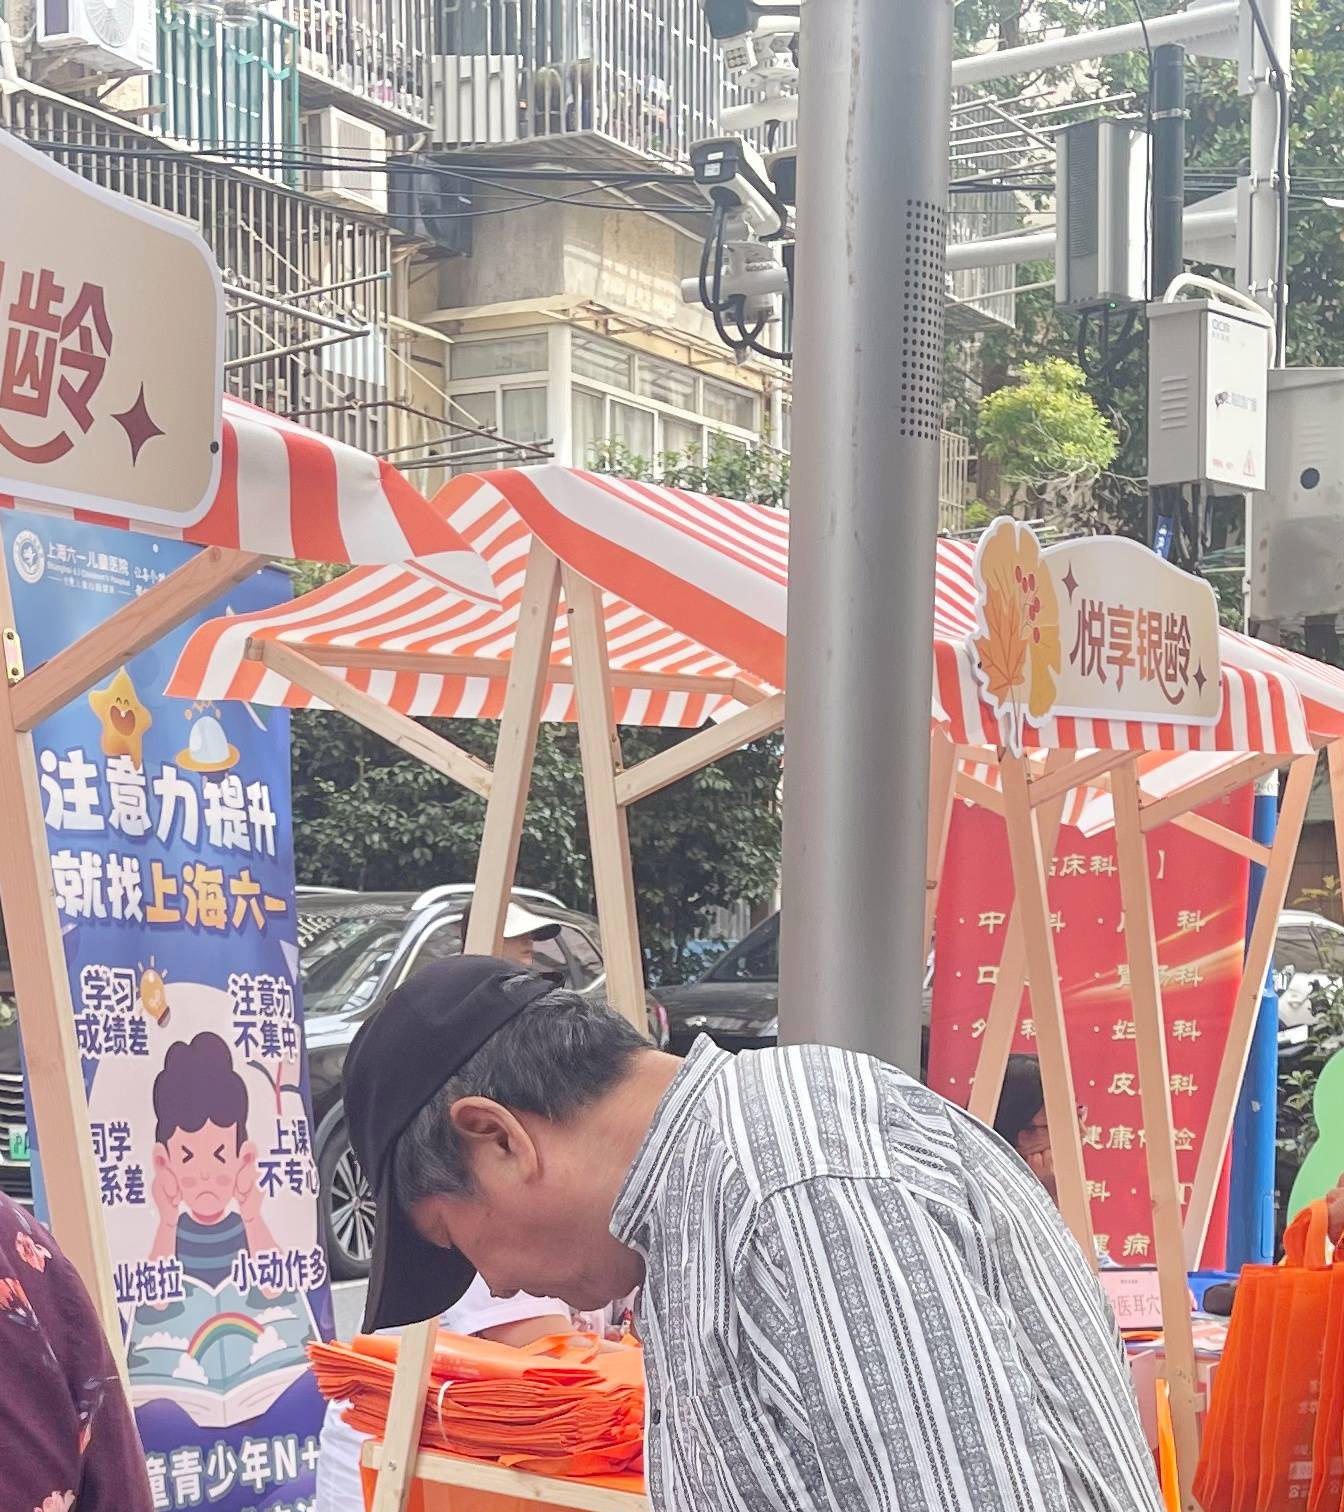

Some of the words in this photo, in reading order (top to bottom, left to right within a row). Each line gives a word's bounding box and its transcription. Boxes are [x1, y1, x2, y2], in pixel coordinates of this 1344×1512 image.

[1069, 598, 1190, 705] 悦享银龄
[40, 750, 277, 855] 注意力提升
[51, 850, 287, 931] 就找上海六一
[83, 968, 134, 1011] 学习
[231, 977, 293, 1018] 注意力
[75, 1013, 150, 1056] 成绩差
[233, 1020, 298, 1061] 不集中
[270, 1119, 309, 1156] 上课
[99, 1164, 146, 1206] 系差
[258, 1158, 320, 1198] 不专心
[233, 1249, 327, 1292] 小动作多
